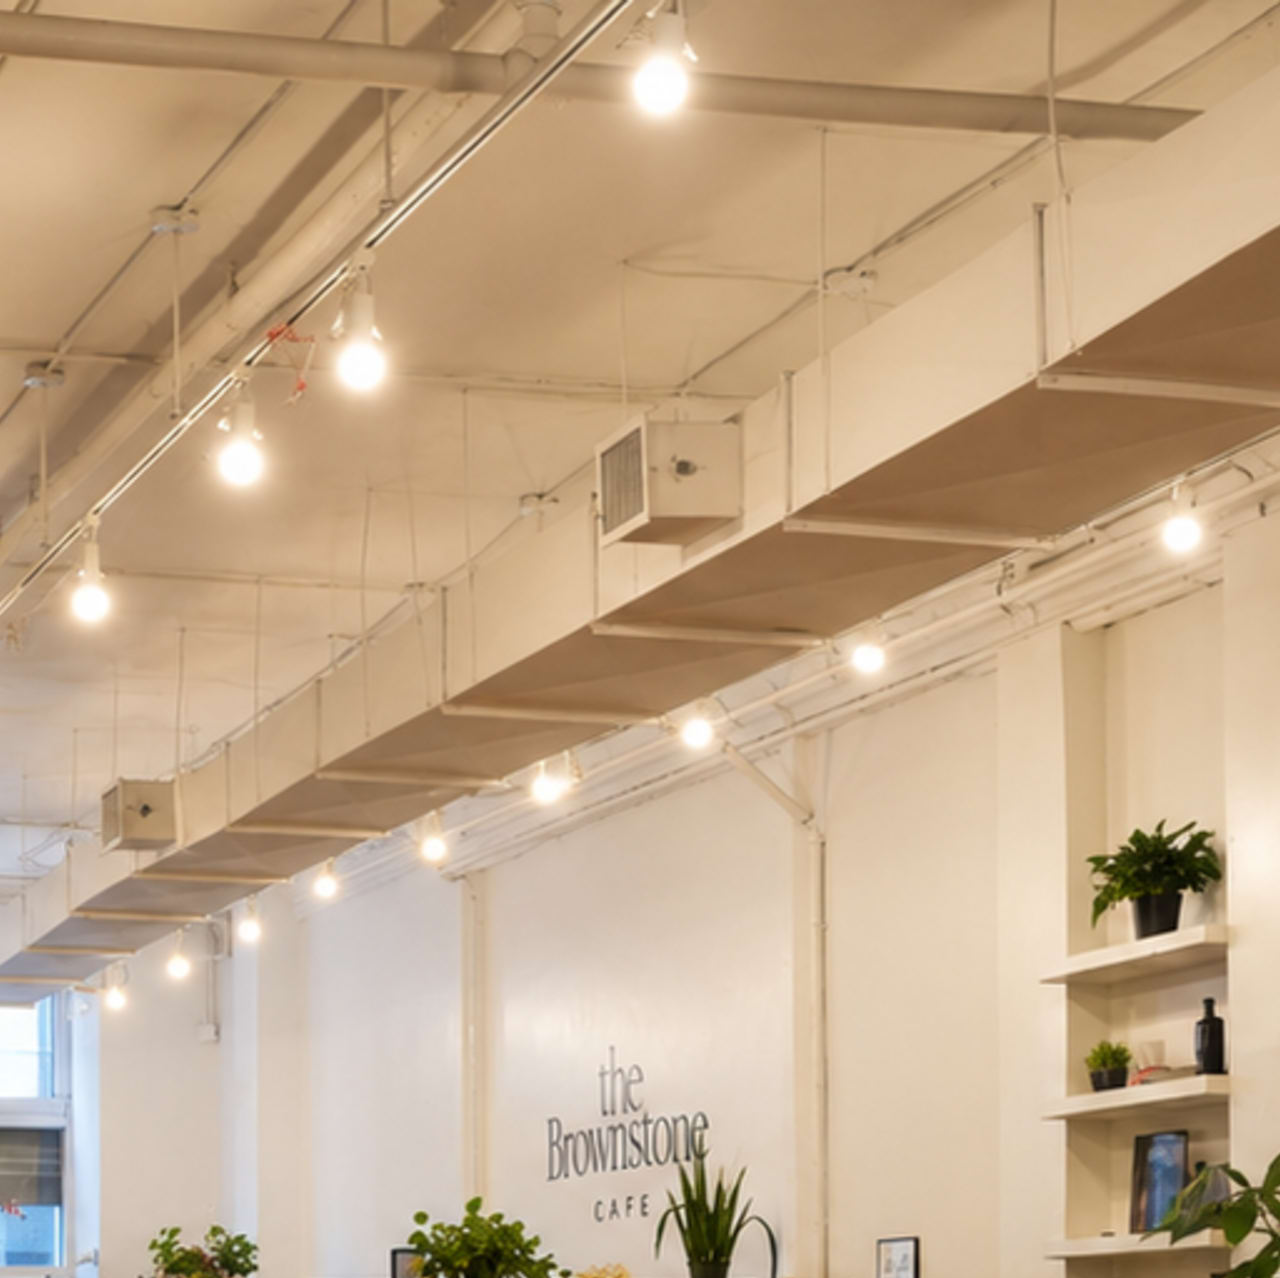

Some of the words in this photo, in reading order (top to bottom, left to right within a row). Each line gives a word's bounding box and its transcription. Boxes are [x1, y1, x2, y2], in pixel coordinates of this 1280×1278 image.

[597, 1044, 645, 1117] the
[546, 1110, 710, 1183] Brownstone
[593, 1193, 650, 1222] CAFE
